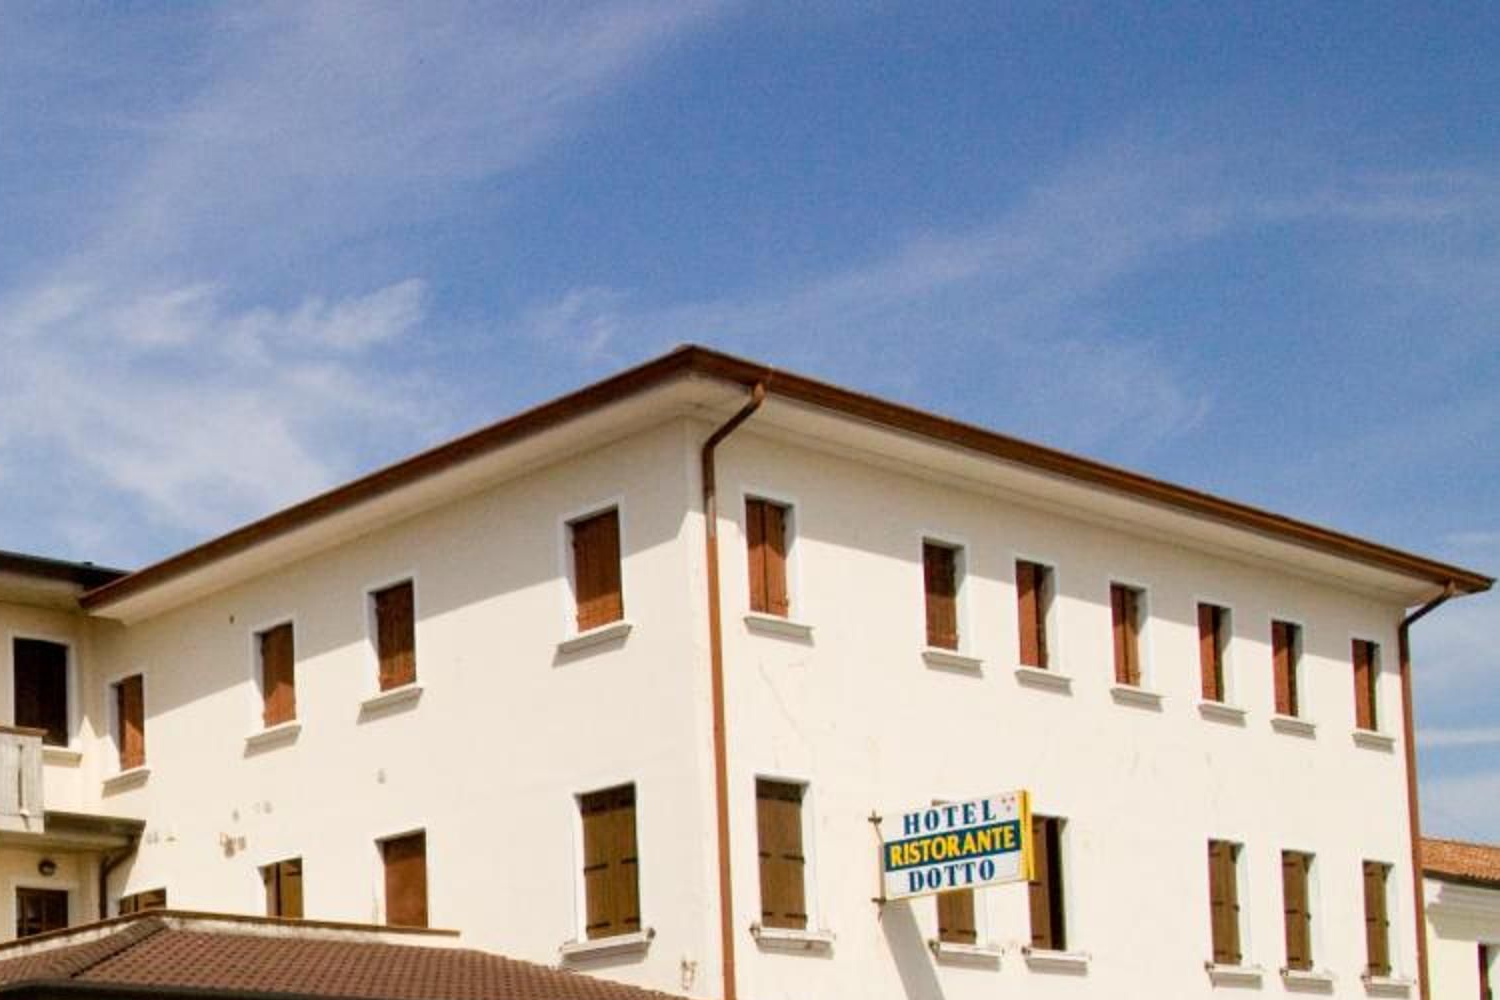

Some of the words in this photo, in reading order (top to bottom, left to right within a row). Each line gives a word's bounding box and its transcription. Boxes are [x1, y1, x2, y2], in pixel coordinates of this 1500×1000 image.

[904, 800, 996, 835] HOTEL
[890, 825, 1015, 866] RISTORANTE
[908, 859, 995, 892] DOTTO
